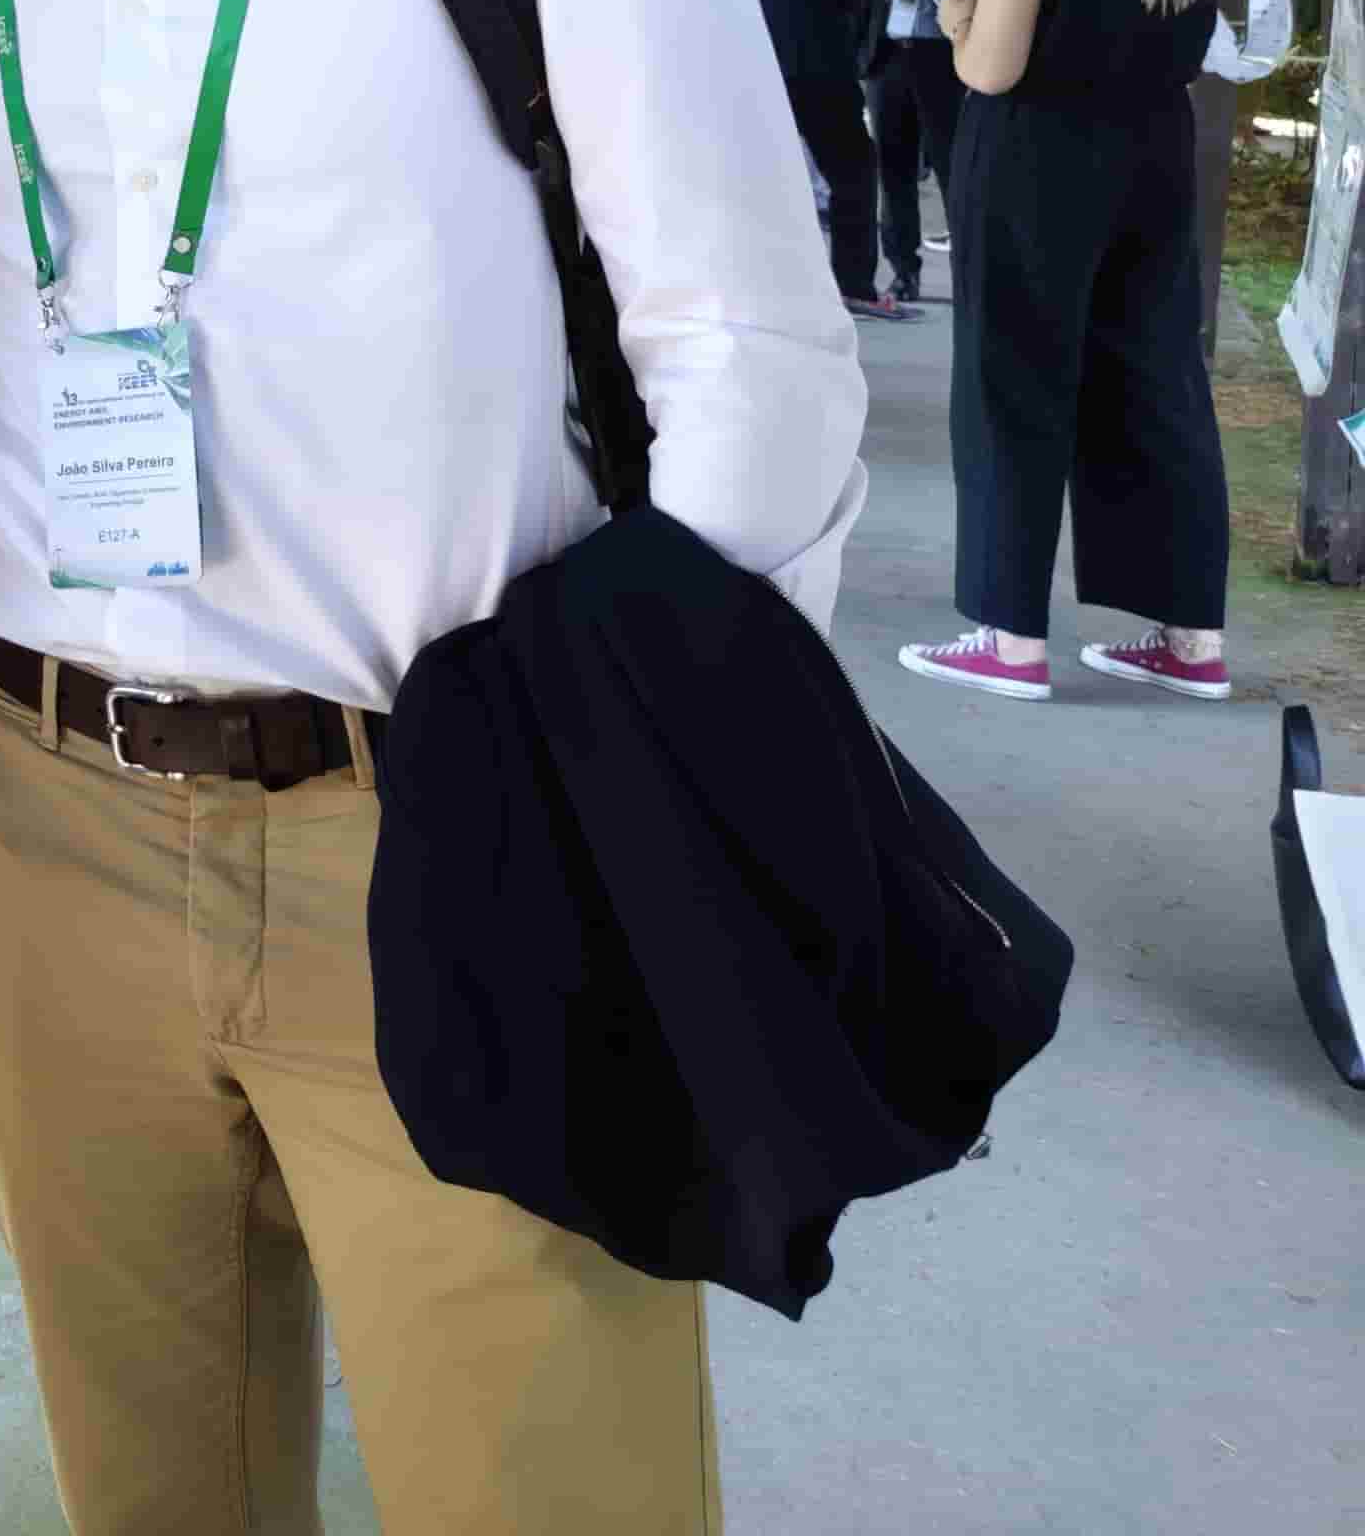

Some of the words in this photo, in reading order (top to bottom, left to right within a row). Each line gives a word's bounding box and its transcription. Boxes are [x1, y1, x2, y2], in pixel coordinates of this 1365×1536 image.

[56, 461, 88, 478] João
[92, 458, 124, 474] Silva
[127, 455, 174, 471] Pereira
